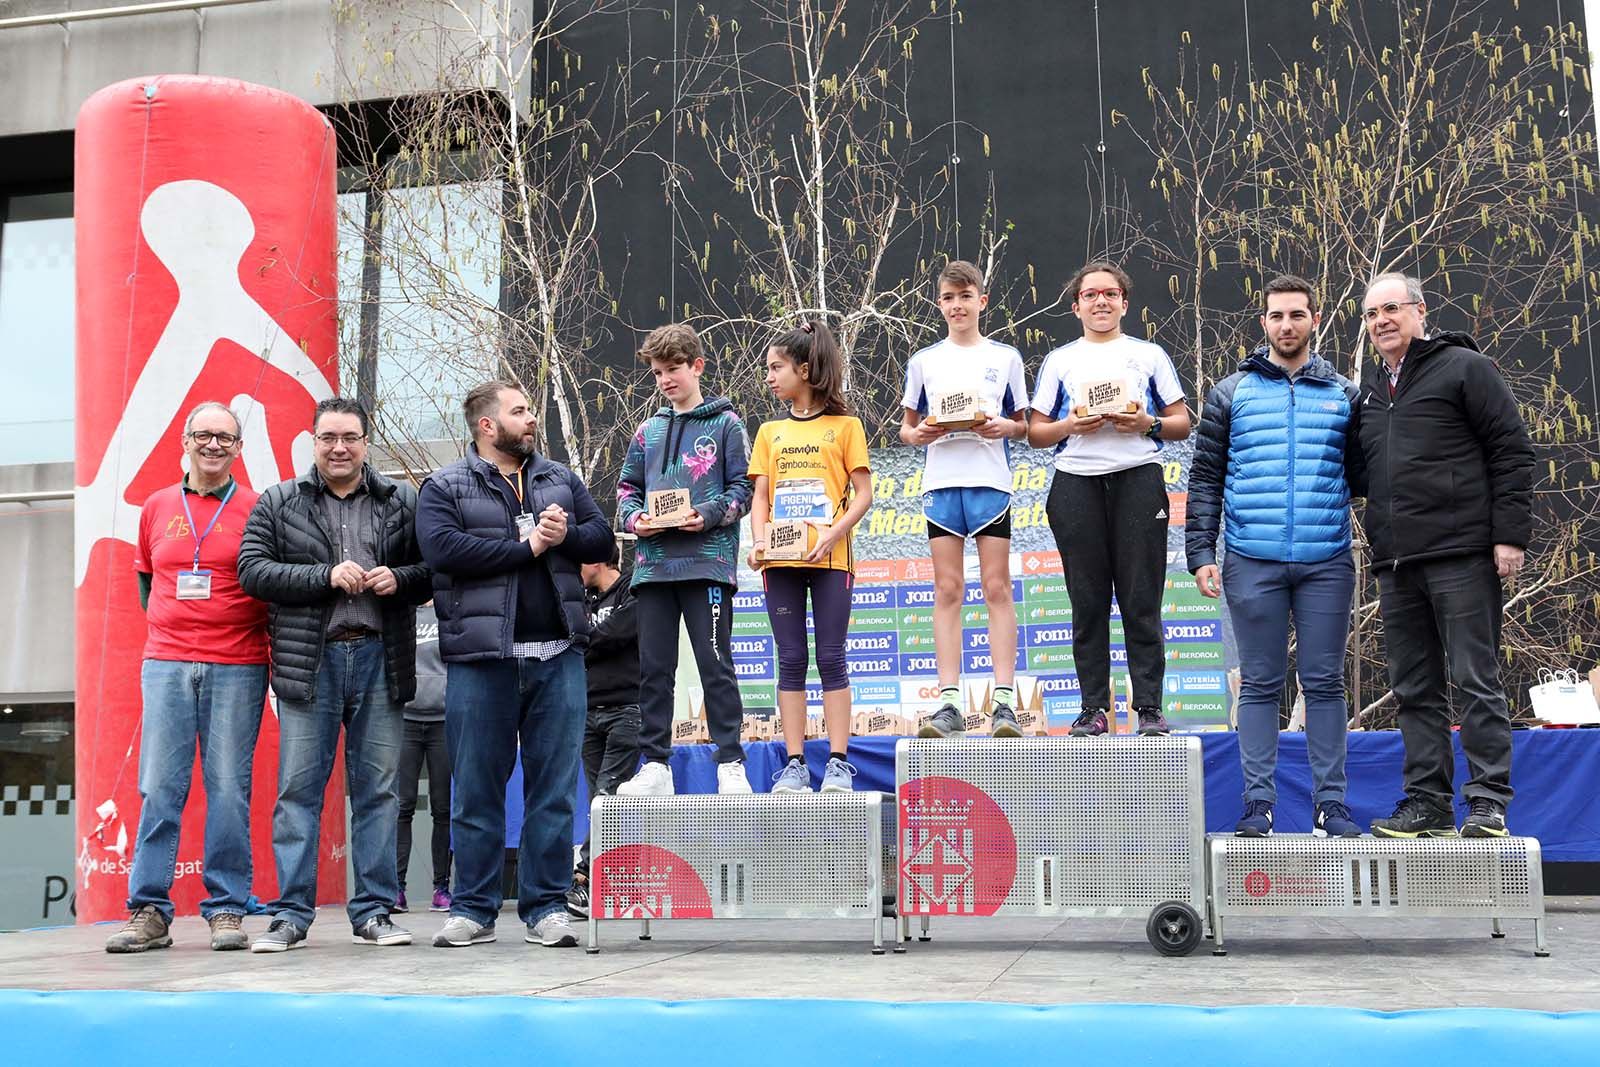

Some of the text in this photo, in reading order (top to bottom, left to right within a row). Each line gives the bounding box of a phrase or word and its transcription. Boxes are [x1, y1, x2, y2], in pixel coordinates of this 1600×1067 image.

[785, 505, 812, 516] 7307
[707, 586, 722, 604] 19
[710, 603, 721, 661] Champion
[1182, 703, 1223, 711] IBERDROLA
[101, 858, 116, 874] de
